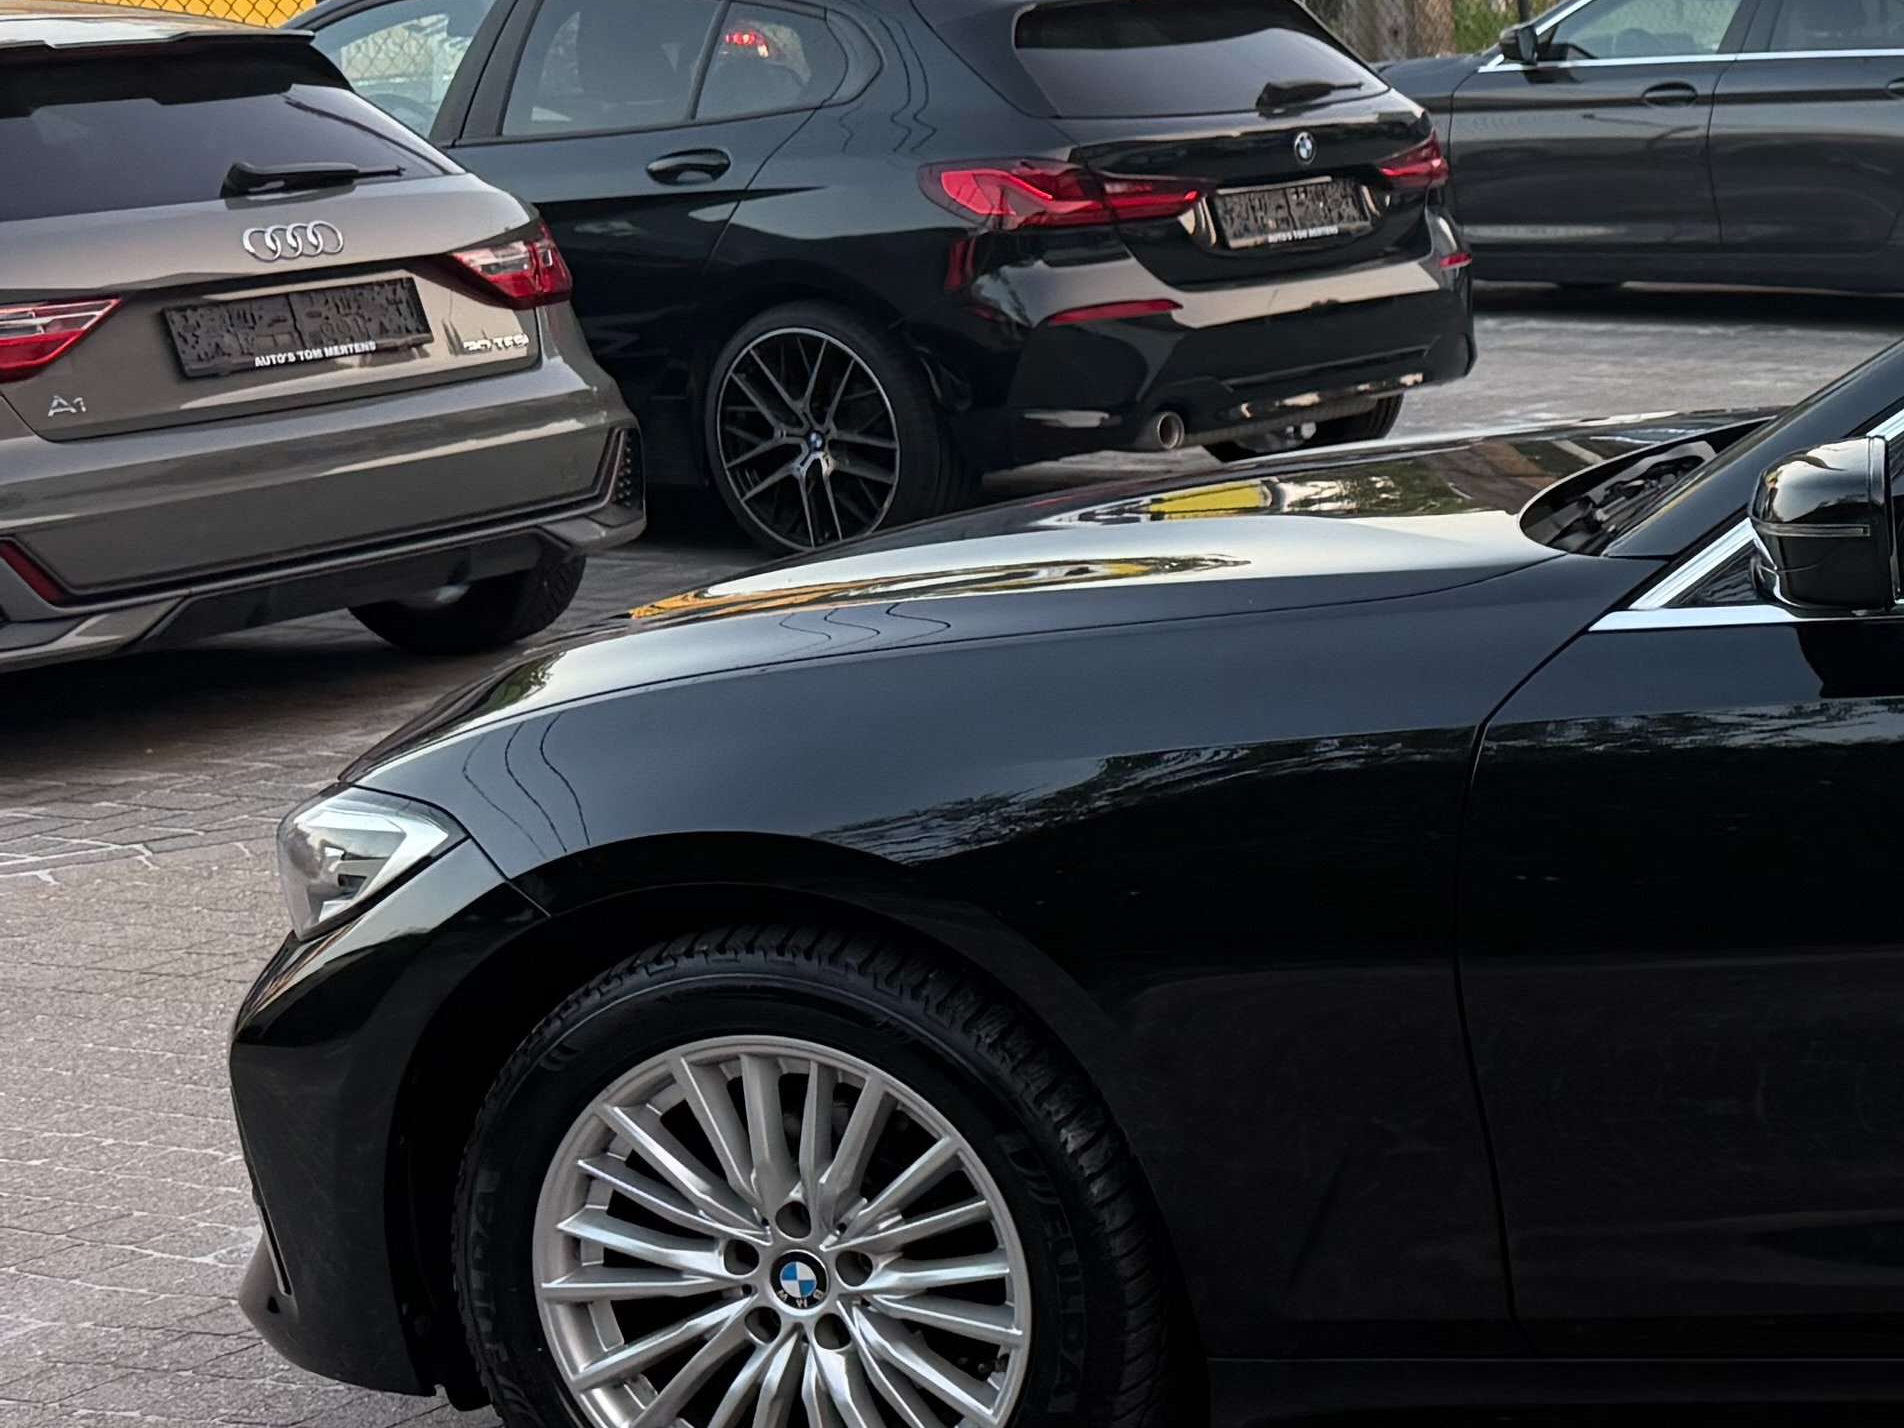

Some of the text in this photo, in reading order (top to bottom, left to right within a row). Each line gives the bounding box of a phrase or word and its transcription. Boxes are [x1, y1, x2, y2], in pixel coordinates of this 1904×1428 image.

[255, 340, 376, 367] AUTO'S TOM MERTENS
